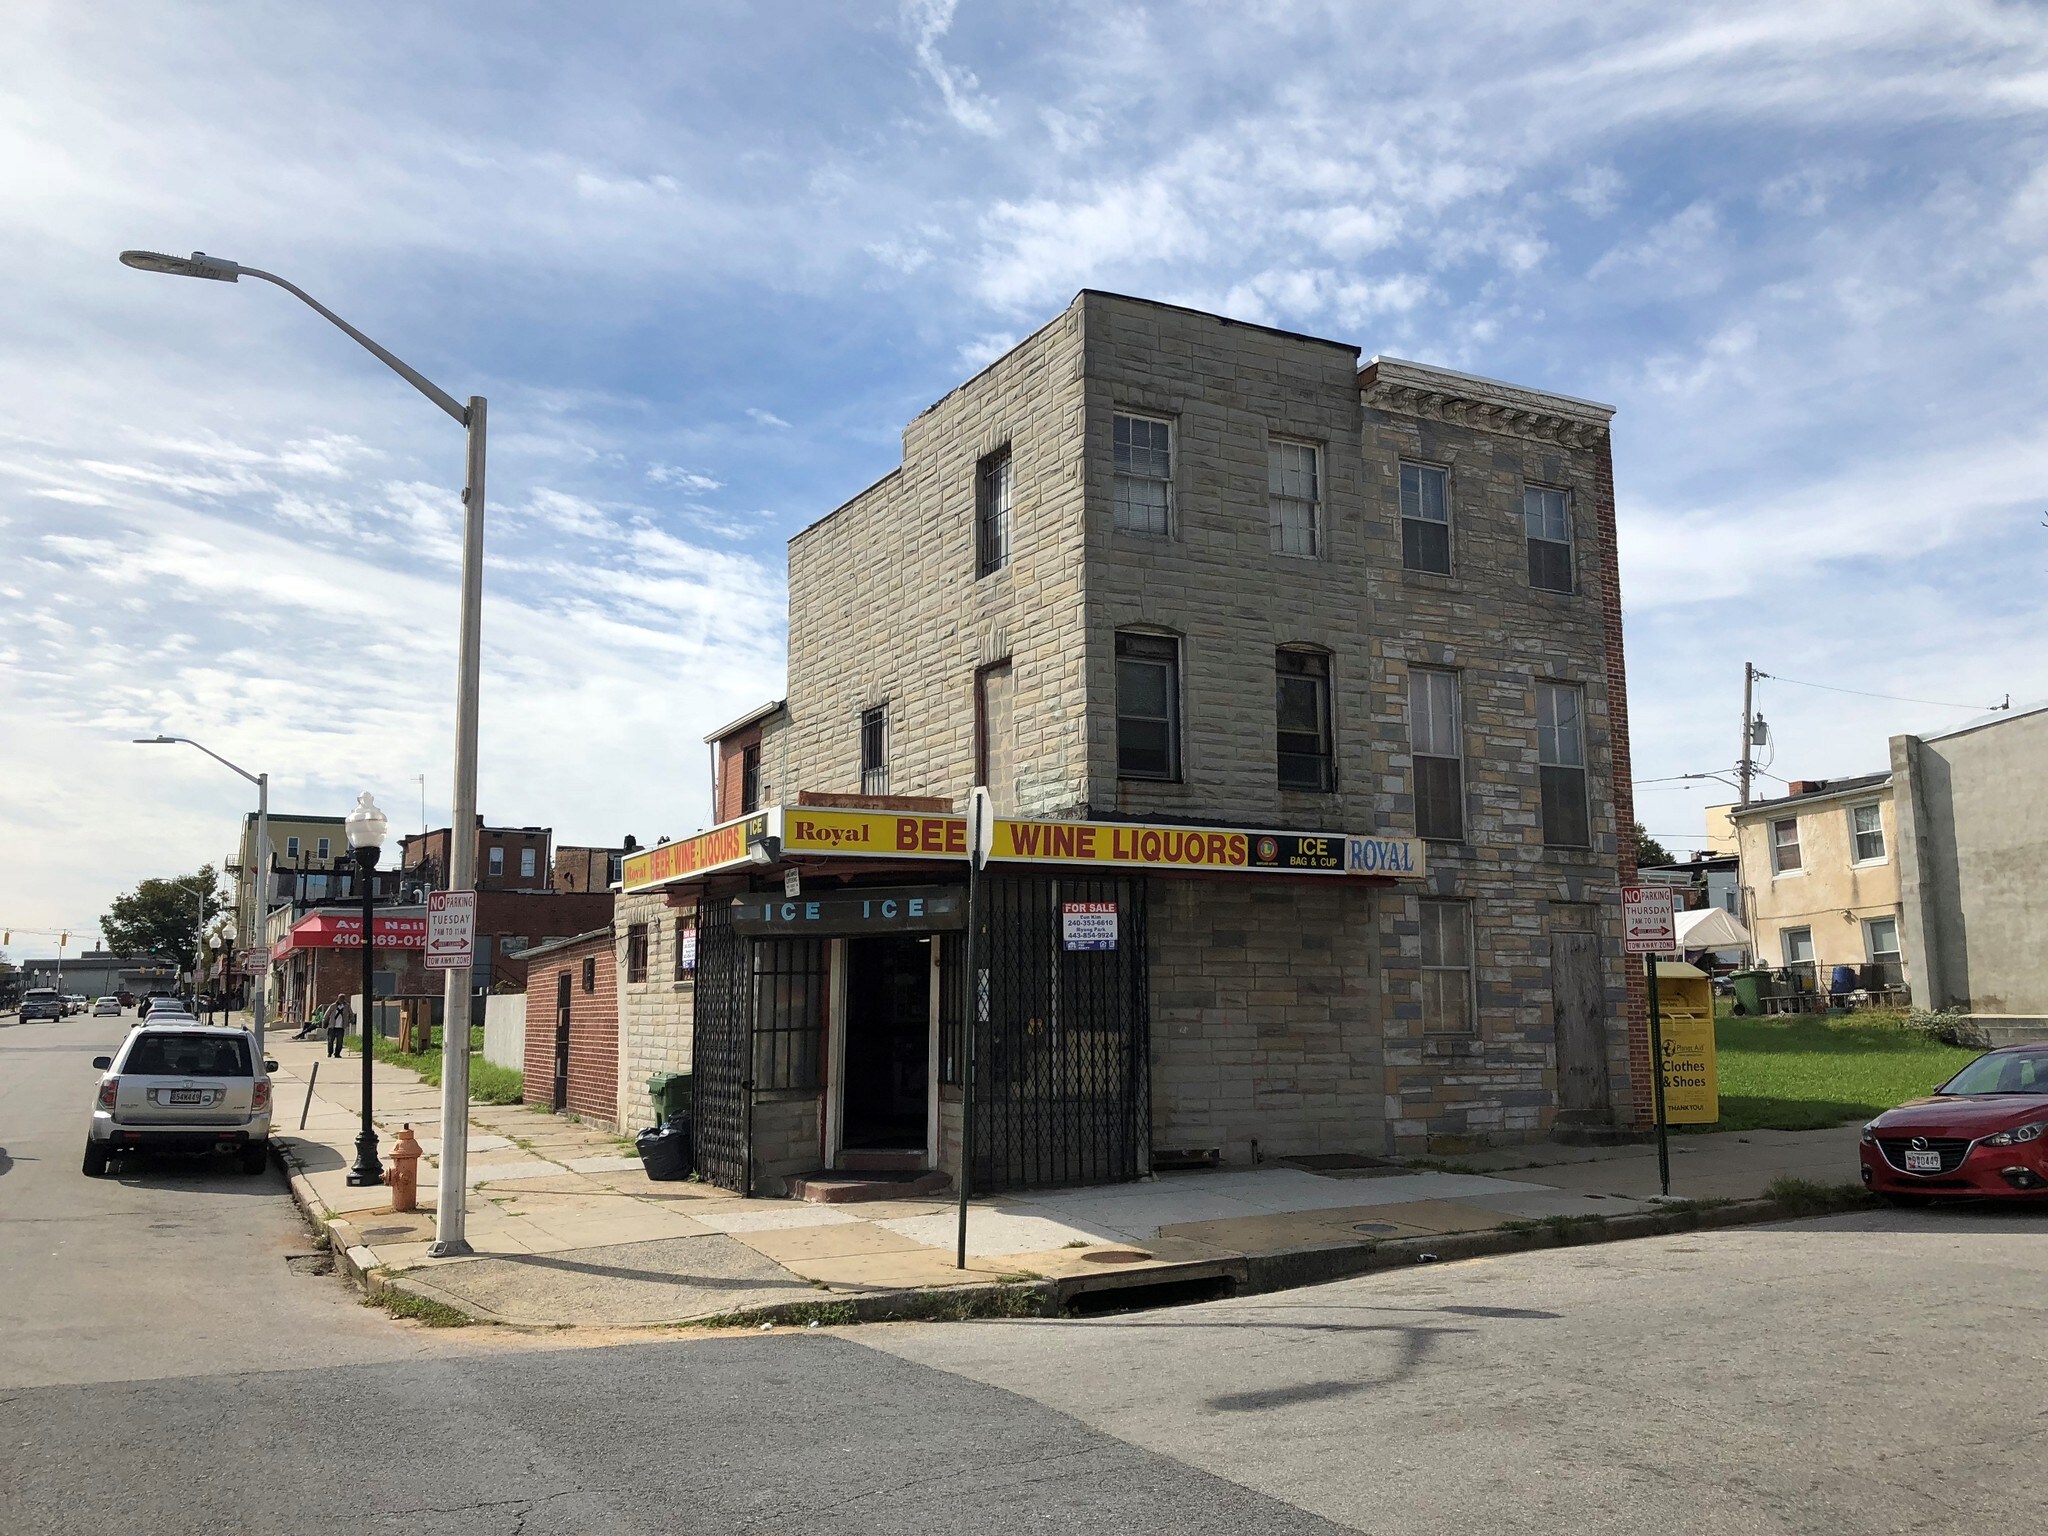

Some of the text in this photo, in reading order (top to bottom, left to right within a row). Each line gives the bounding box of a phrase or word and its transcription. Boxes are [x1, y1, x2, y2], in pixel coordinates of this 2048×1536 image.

[750, 817, 763, 835] ICE
[795, 818, 1247, 866] Royal BEE WINE LIQUORS
[1298, 838, 1328, 856] ICE
[650, 826, 740, 881] BEER WINE LIQOURS
[1350, 840, 1415, 872] ROYAL
[1290, 856, 1308, 866] BAG
[1310, 857, 1317, 867] &
[1320, 858, 1338, 868] CUP
[626, 863, 646, 884] Royal
[1625, 890, 1669, 903] NO PARKING
[430, 896, 473, 911] NO PARKING
[1065, 903, 1115, 913] FOR SALE
[764, 898, 924, 922] ICE ICE
[1626, 906, 1671, 915] THURSDAY
[336, 920, 363, 929] Av
[432, 915, 471, 925] TUESDAY
[434, 928, 445, 936] 7AM
[455, 927, 467, 935] 11AM
[333, 933, 426, 946] 410-69-012
[1659, 941, 1673, 949] ZONE
[428, 956, 470, 965] TOW AWAY ZONE
[1663, 1060, 1705, 1072] Clothes
[1663, 1075, 1706, 1087] & Shoes
